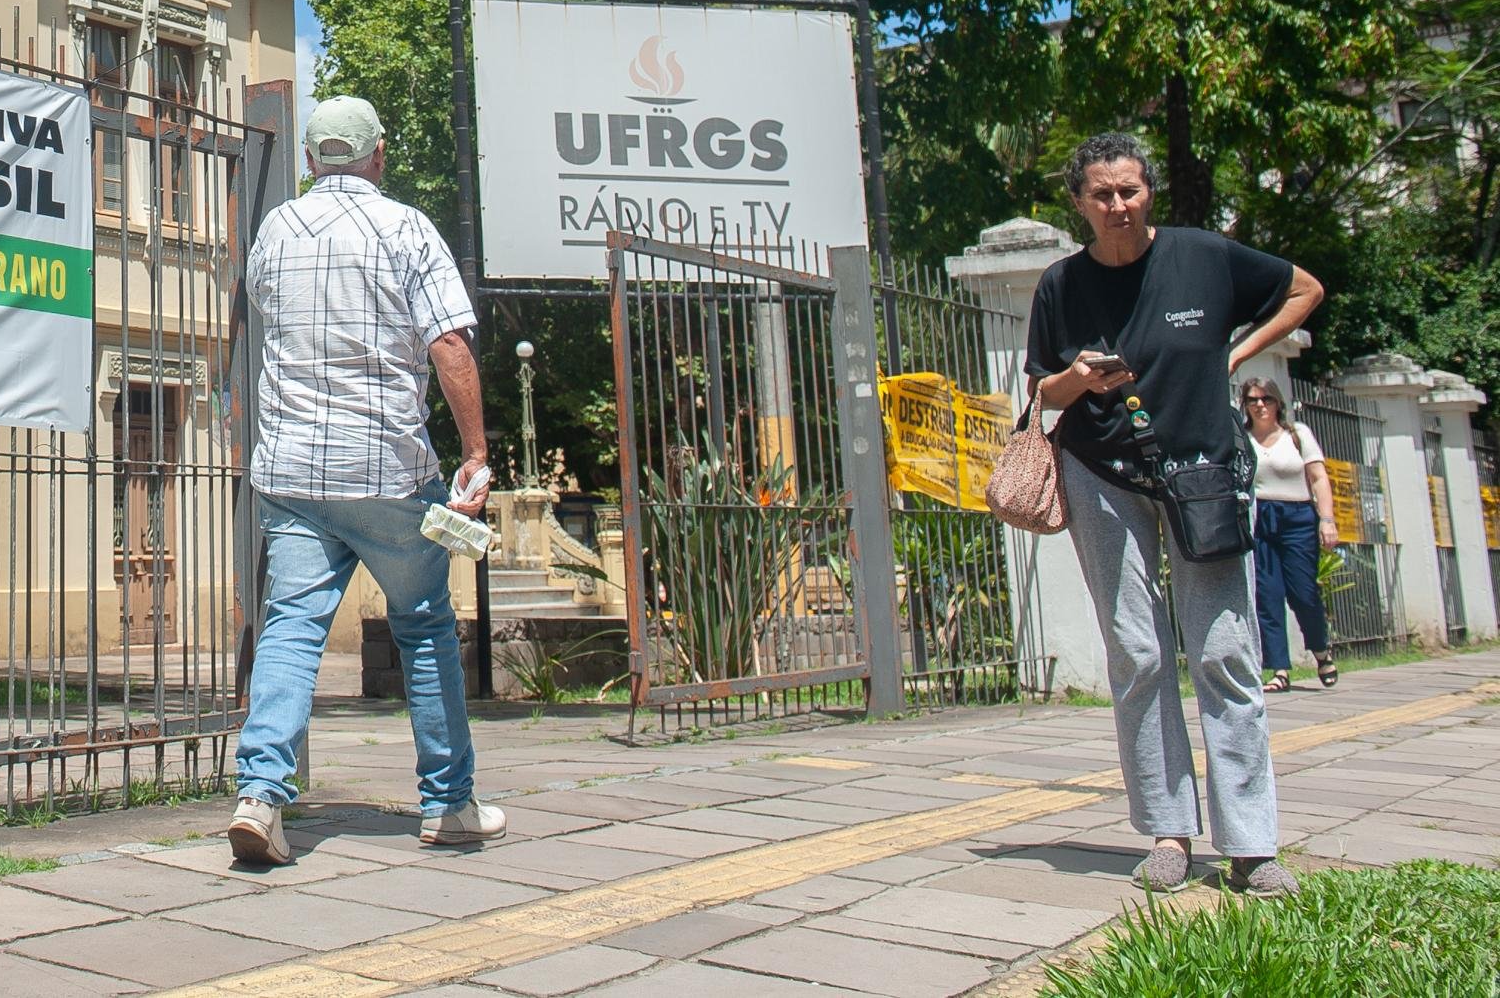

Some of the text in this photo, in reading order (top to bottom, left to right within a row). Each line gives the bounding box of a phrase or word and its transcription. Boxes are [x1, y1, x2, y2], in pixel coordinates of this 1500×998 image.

[554, 112, 789, 172] UFRGS
[559, 185, 692, 234] RÁDIO
[742, 201, 791, 236] TV
